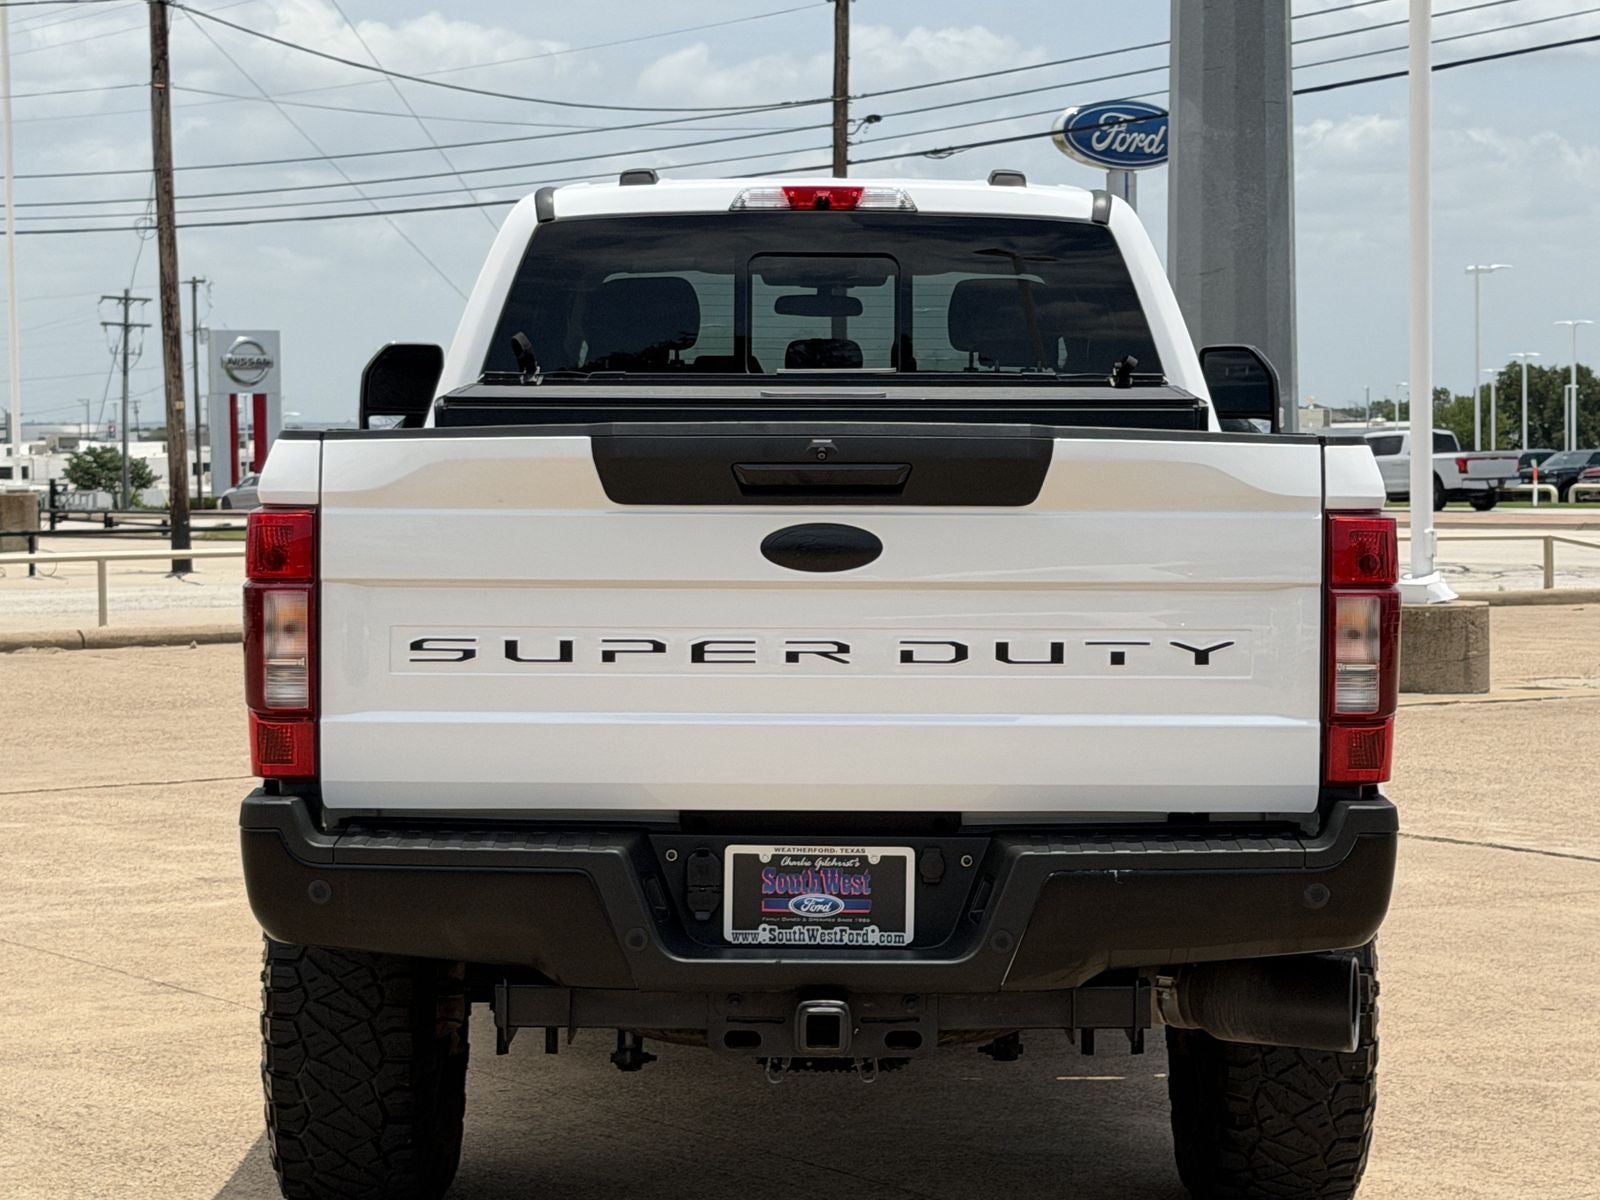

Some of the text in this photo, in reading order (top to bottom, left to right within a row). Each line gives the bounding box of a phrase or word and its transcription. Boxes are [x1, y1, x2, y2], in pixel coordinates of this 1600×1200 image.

[1091, 112, 1167, 155] Ford
[227, 356, 272, 366] NISSAN
[409, 637, 1235, 665] SUPER DUTY
[780, 855, 812, 866] Charlie
[800, 897, 833, 912] Ford
[731, 927, 905, 945] www.SouthWestFord.com
